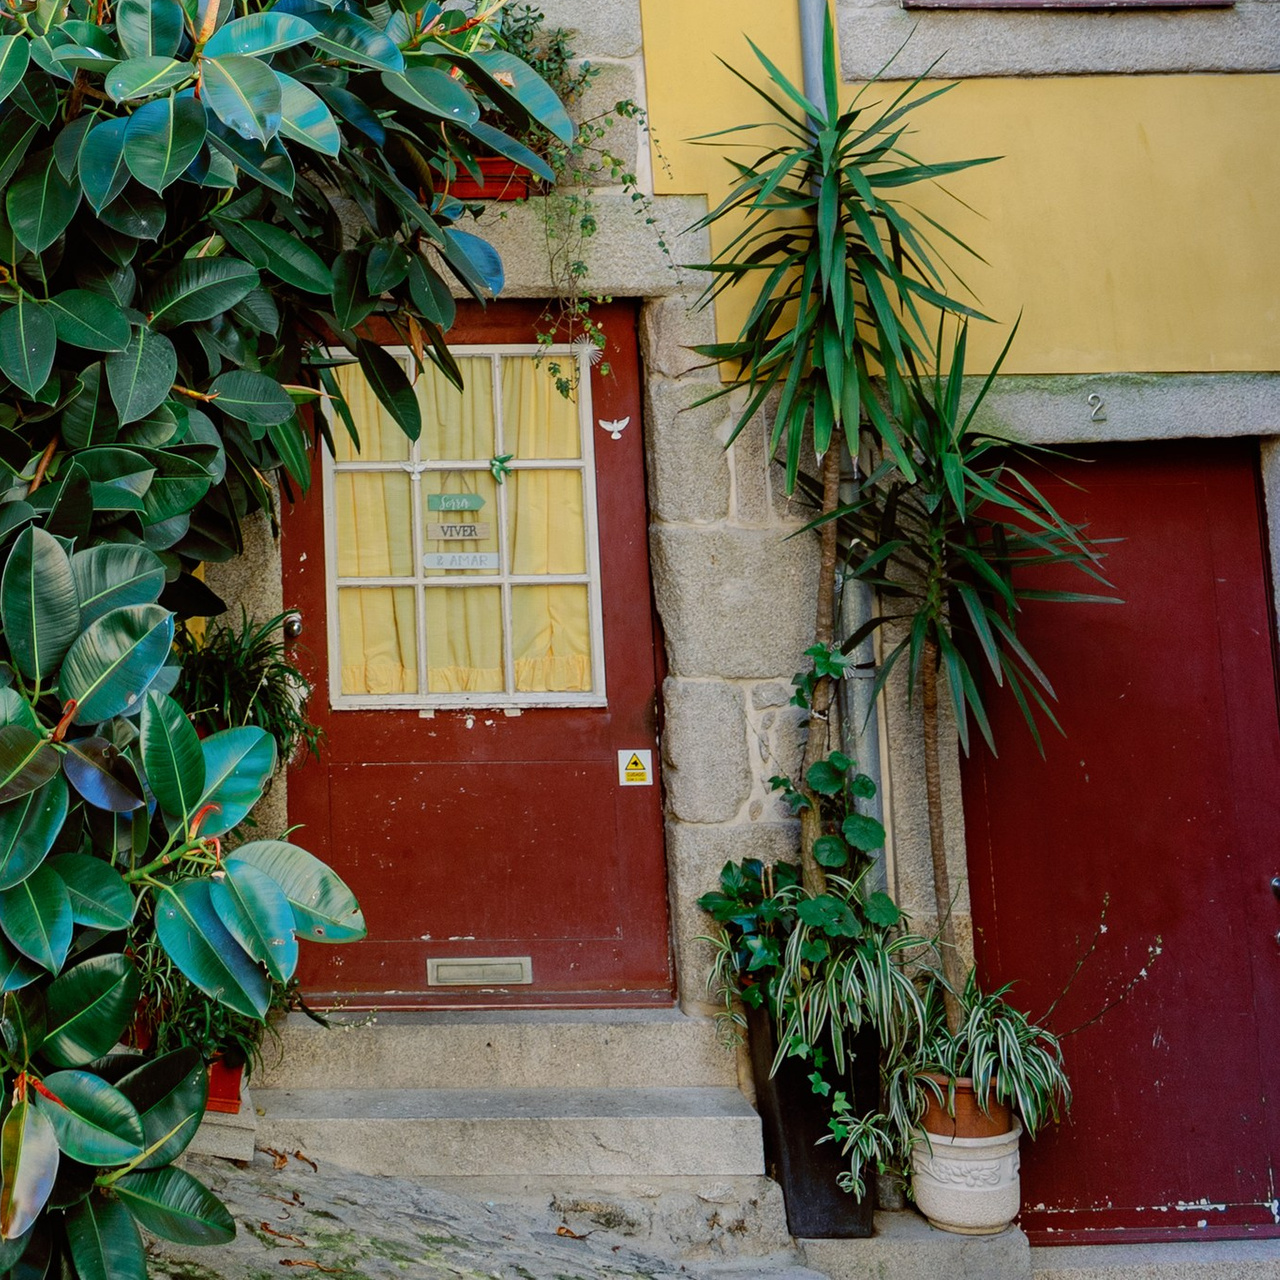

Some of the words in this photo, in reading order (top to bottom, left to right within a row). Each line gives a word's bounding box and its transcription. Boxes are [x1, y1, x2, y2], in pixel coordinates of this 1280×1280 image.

[1088, 393, 1107, 422] 2
[440, 525, 478, 537] VIVER
[450, 555, 489, 566] AMAR
